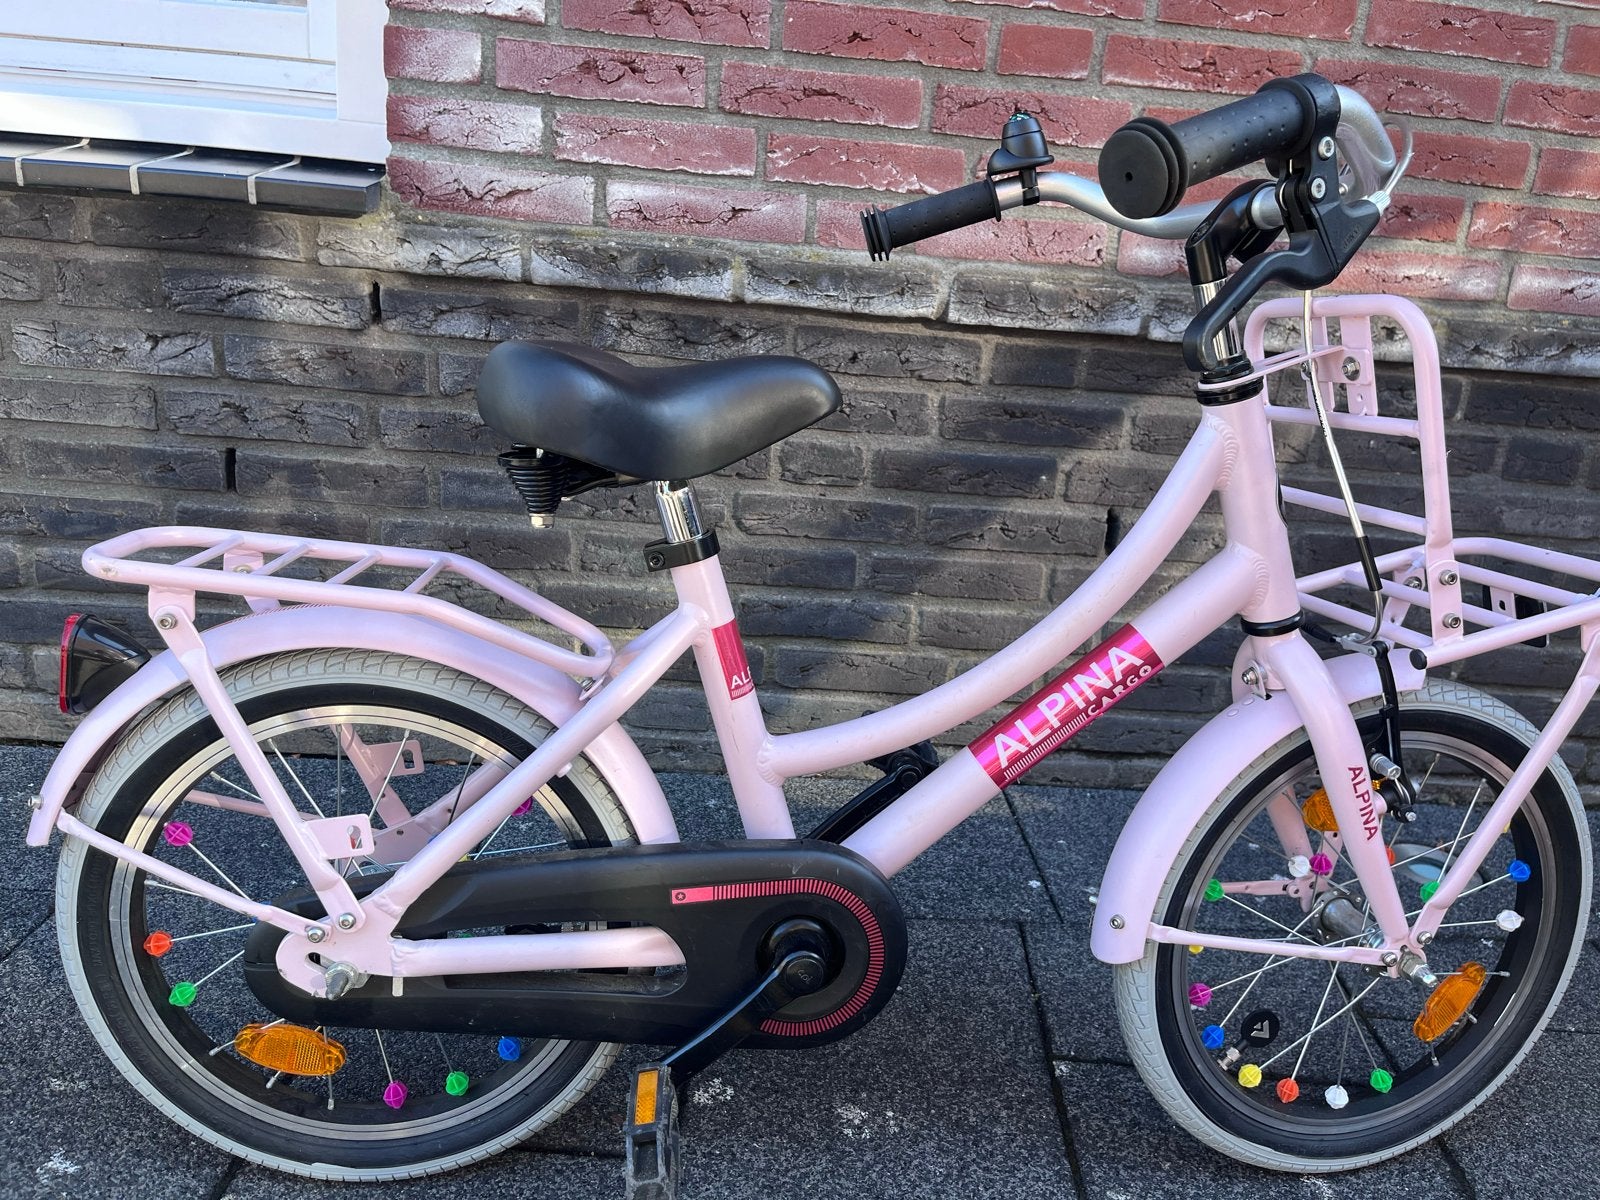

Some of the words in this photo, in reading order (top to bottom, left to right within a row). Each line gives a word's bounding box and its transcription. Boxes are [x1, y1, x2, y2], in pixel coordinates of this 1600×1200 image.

[994, 647, 1144, 768] ALPINA
[1088, 665, 1152, 715] CARGO
[1348, 766, 1378, 840] ALPINA
